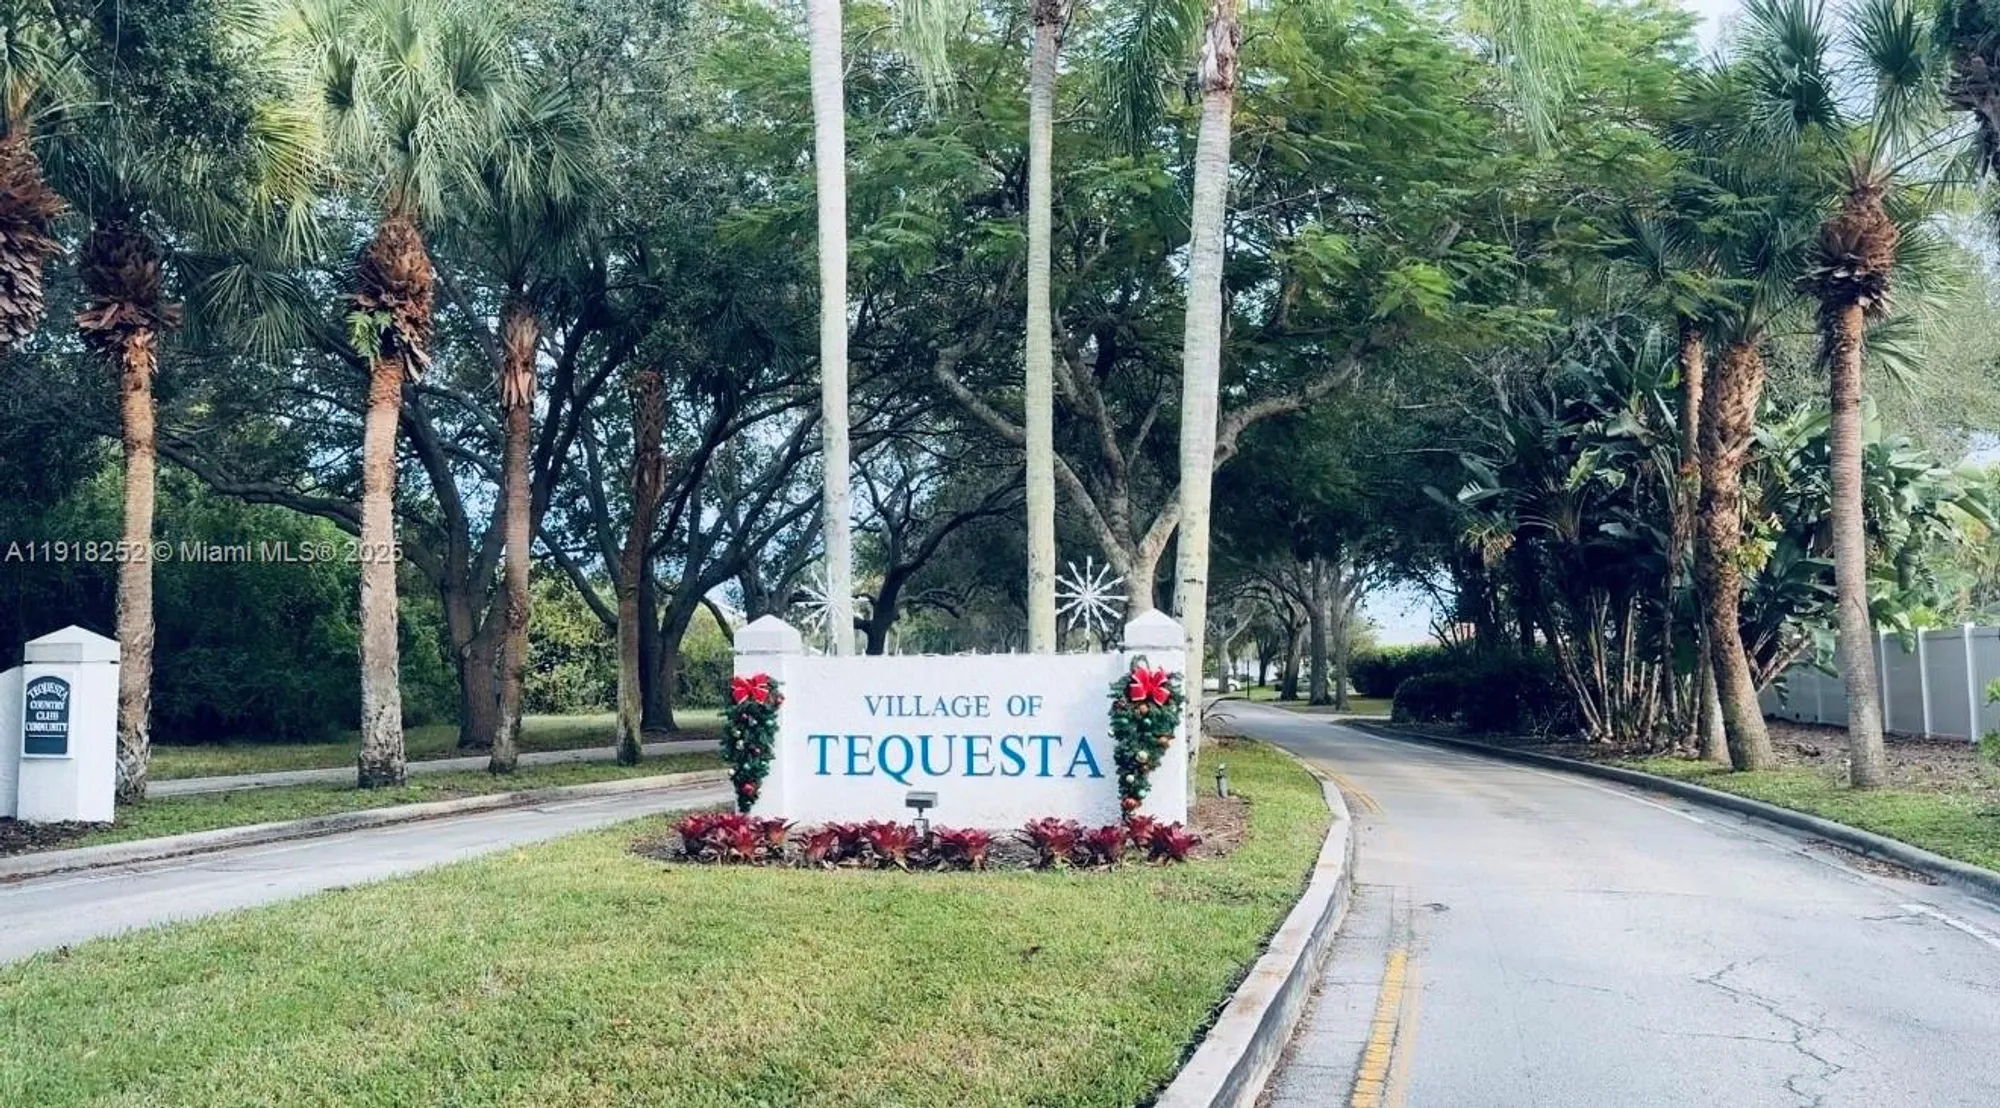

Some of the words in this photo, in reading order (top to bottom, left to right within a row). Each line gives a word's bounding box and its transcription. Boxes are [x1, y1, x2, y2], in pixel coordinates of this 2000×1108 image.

[27, 682, 69, 701] TEQUESTA
[30, 700, 65, 710] COUNTRY
[864, 695, 990, 718] VILLAGE
[1007, 695, 1043, 718] OF
[36, 711, 58, 720] CLUB
[25, 722, 67, 731] COMMUNITY
[808, 734, 1105, 785] TEQUESTA
